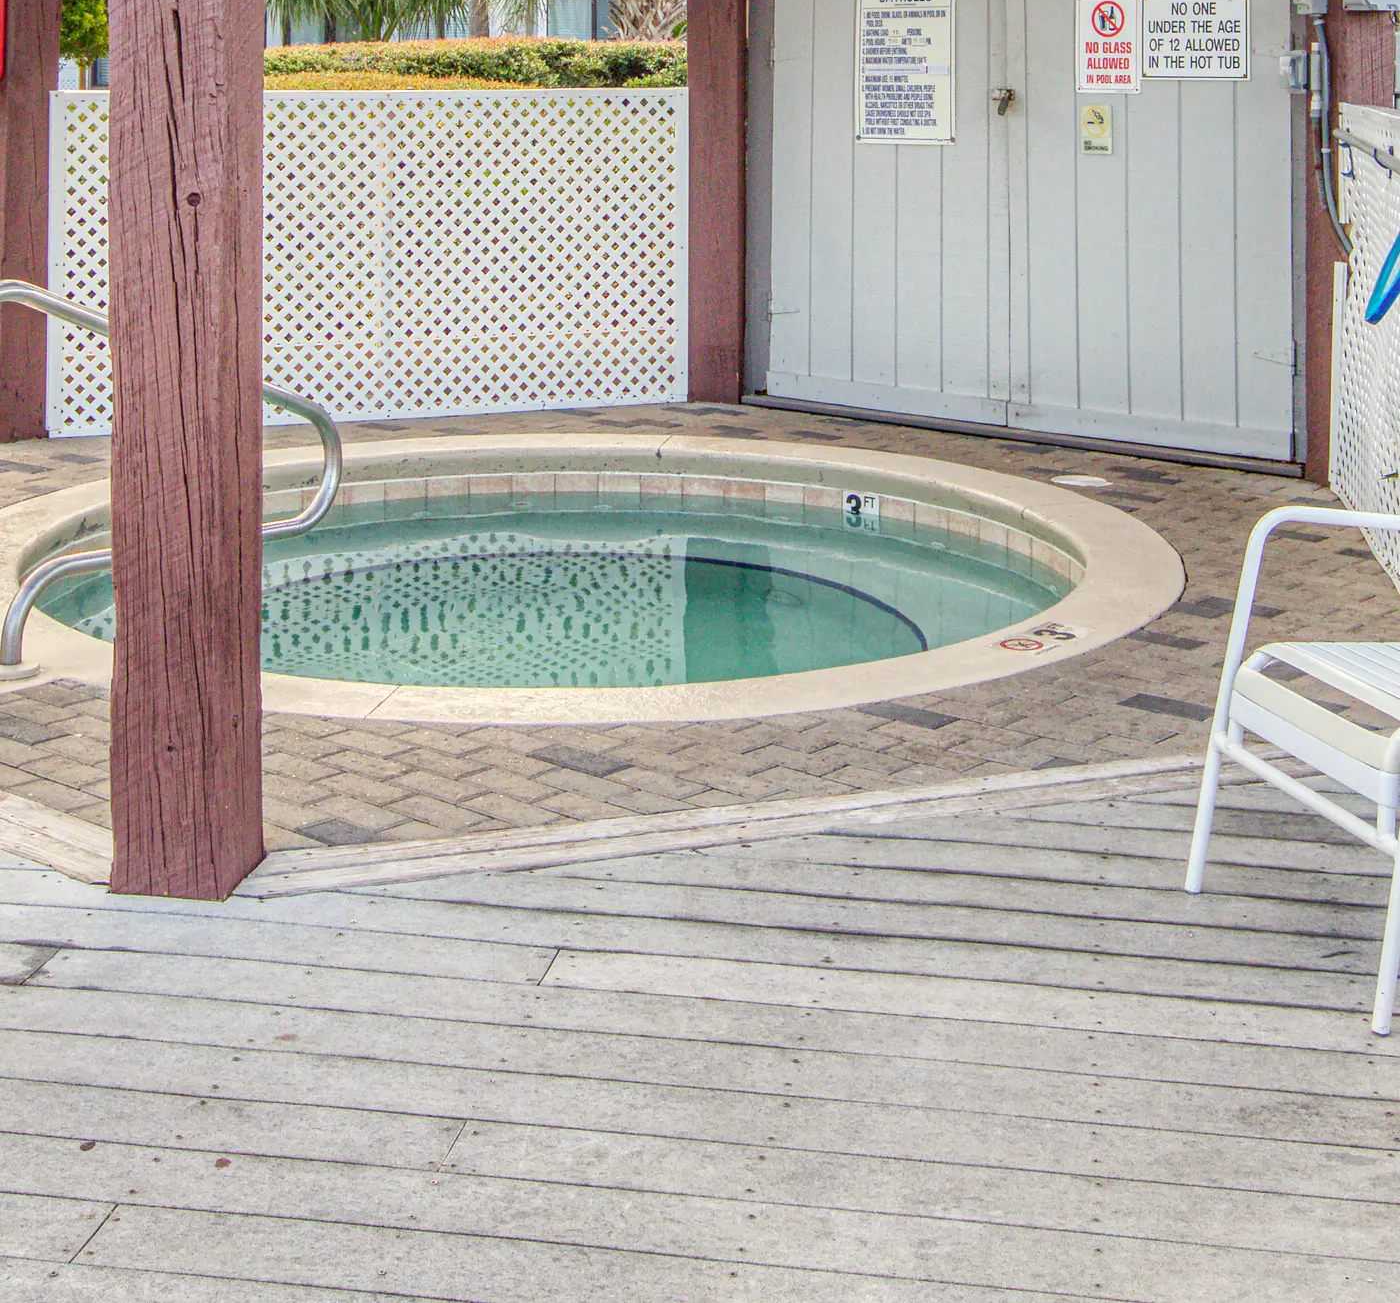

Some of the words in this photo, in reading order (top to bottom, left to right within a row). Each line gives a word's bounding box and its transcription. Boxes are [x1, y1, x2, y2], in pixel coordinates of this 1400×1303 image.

[1171, 2, 1188, 15] NO
[1192, 2, 1217, 15] ONE
[1148, 20, 1186, 34] UNDER
[1191, 20, 1213, 33] THE
[1217, 20, 1241, 33] AGE
[1085, 42, 1099, 54] NO
[1102, 42, 1132, 54] GLASS
[1149, 39, 1164, 52] OF
[1169, 39, 1181, 52] 12
[1185, 39, 1240, 52] ALLOWED
[1086, 57, 1130, 70] ALLOWED
[1148, 56, 1159, 69] IN
[1164, 56, 1186, 69] THE
[1190, 56, 1213, 69] HOT
[1217, 56, 1241, 69] TUB
[865, 75, 881, 83] MAXIMUM
[1086, 74, 1094, 84] IN
[1096, 74, 1113, 84] POOL
[1114, 74, 1132, 84] AREA
[846, 494, 861, 515] 3
[864, 495, 875, 508] FT
